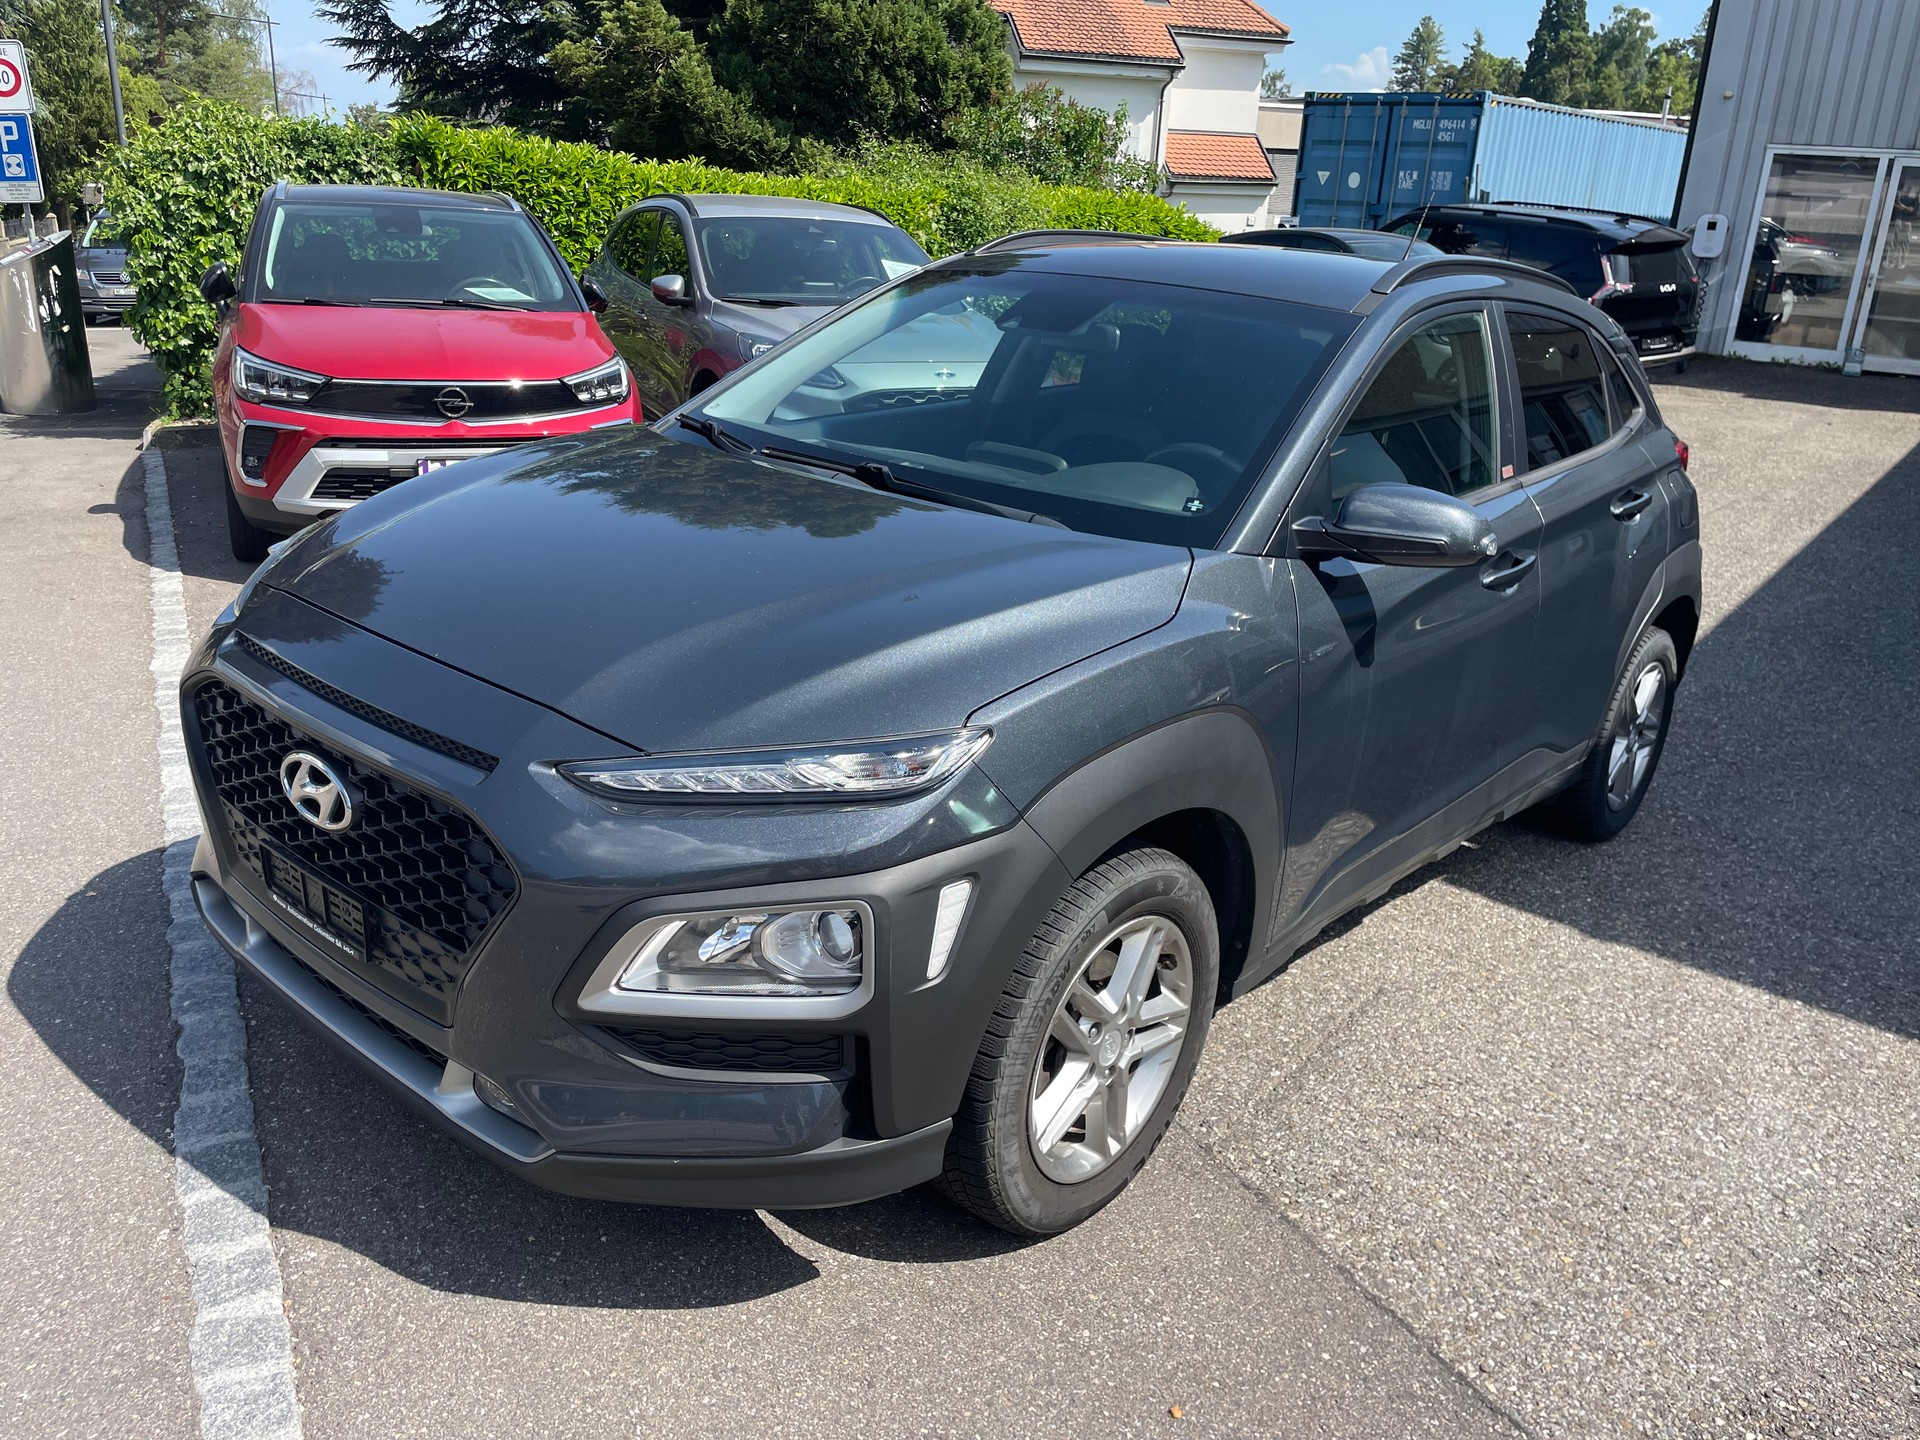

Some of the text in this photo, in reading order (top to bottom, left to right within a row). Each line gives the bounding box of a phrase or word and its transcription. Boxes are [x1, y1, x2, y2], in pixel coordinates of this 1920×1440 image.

[1412, 119, 1432, 130] MGLU
[1438, 119, 1466, 130] 496414
[0, 121, 19, 152] P
[1437, 131, 1456, 142] 45G1
